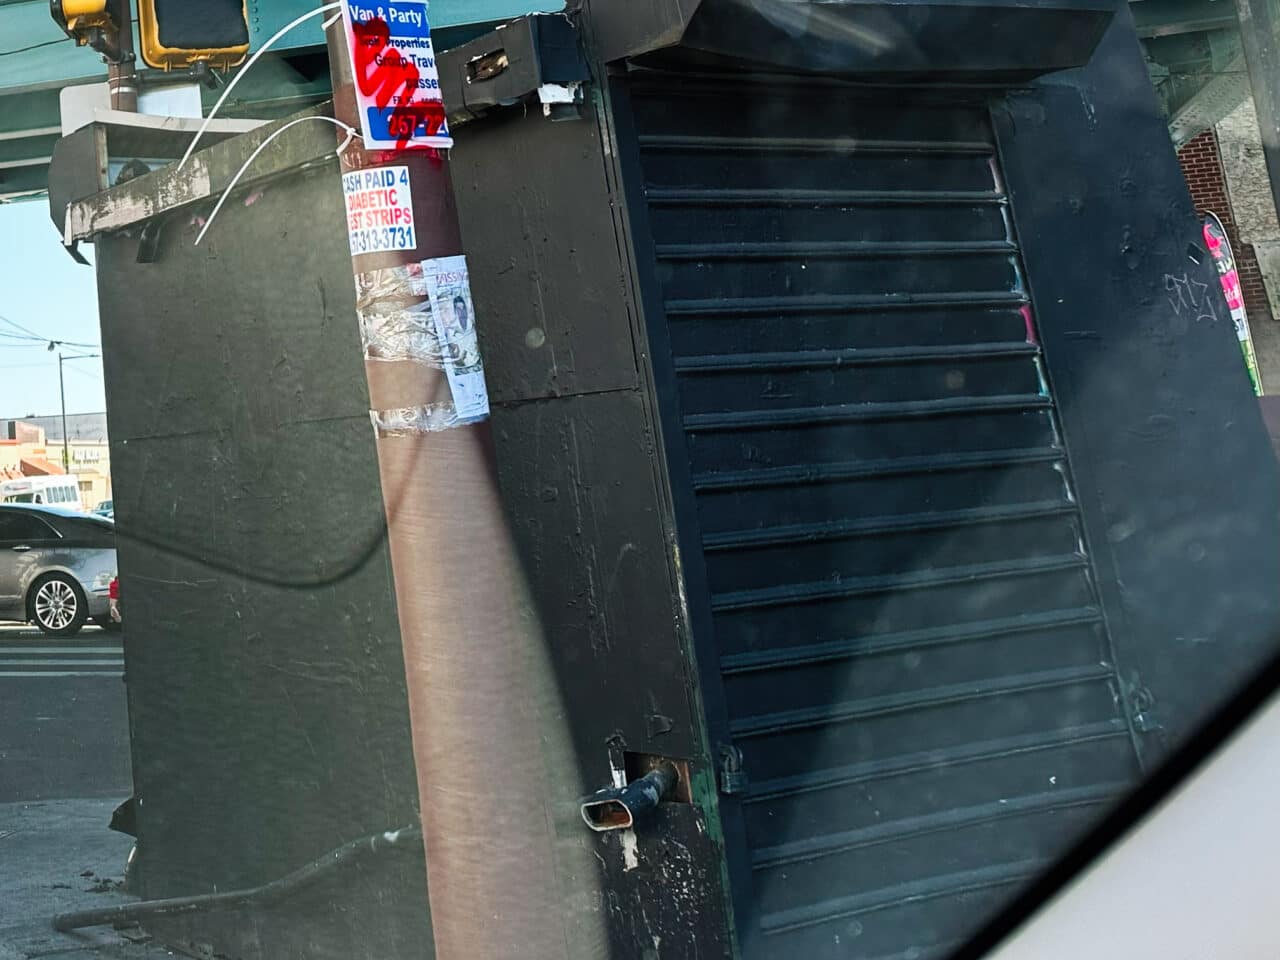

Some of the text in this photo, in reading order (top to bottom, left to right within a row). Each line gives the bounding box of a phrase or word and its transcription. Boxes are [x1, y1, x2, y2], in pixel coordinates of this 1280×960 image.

[349, 5, 422, 28] Van & Party
[386, 37, 431, 50] Properties
[375, 53, 409, 69] Group
[365, 170, 395, 189] PAID
[400, 169, 408, 186] 4
[349, 188, 398, 211] DIABETIC
[366, 207, 412, 227] STRIPS
